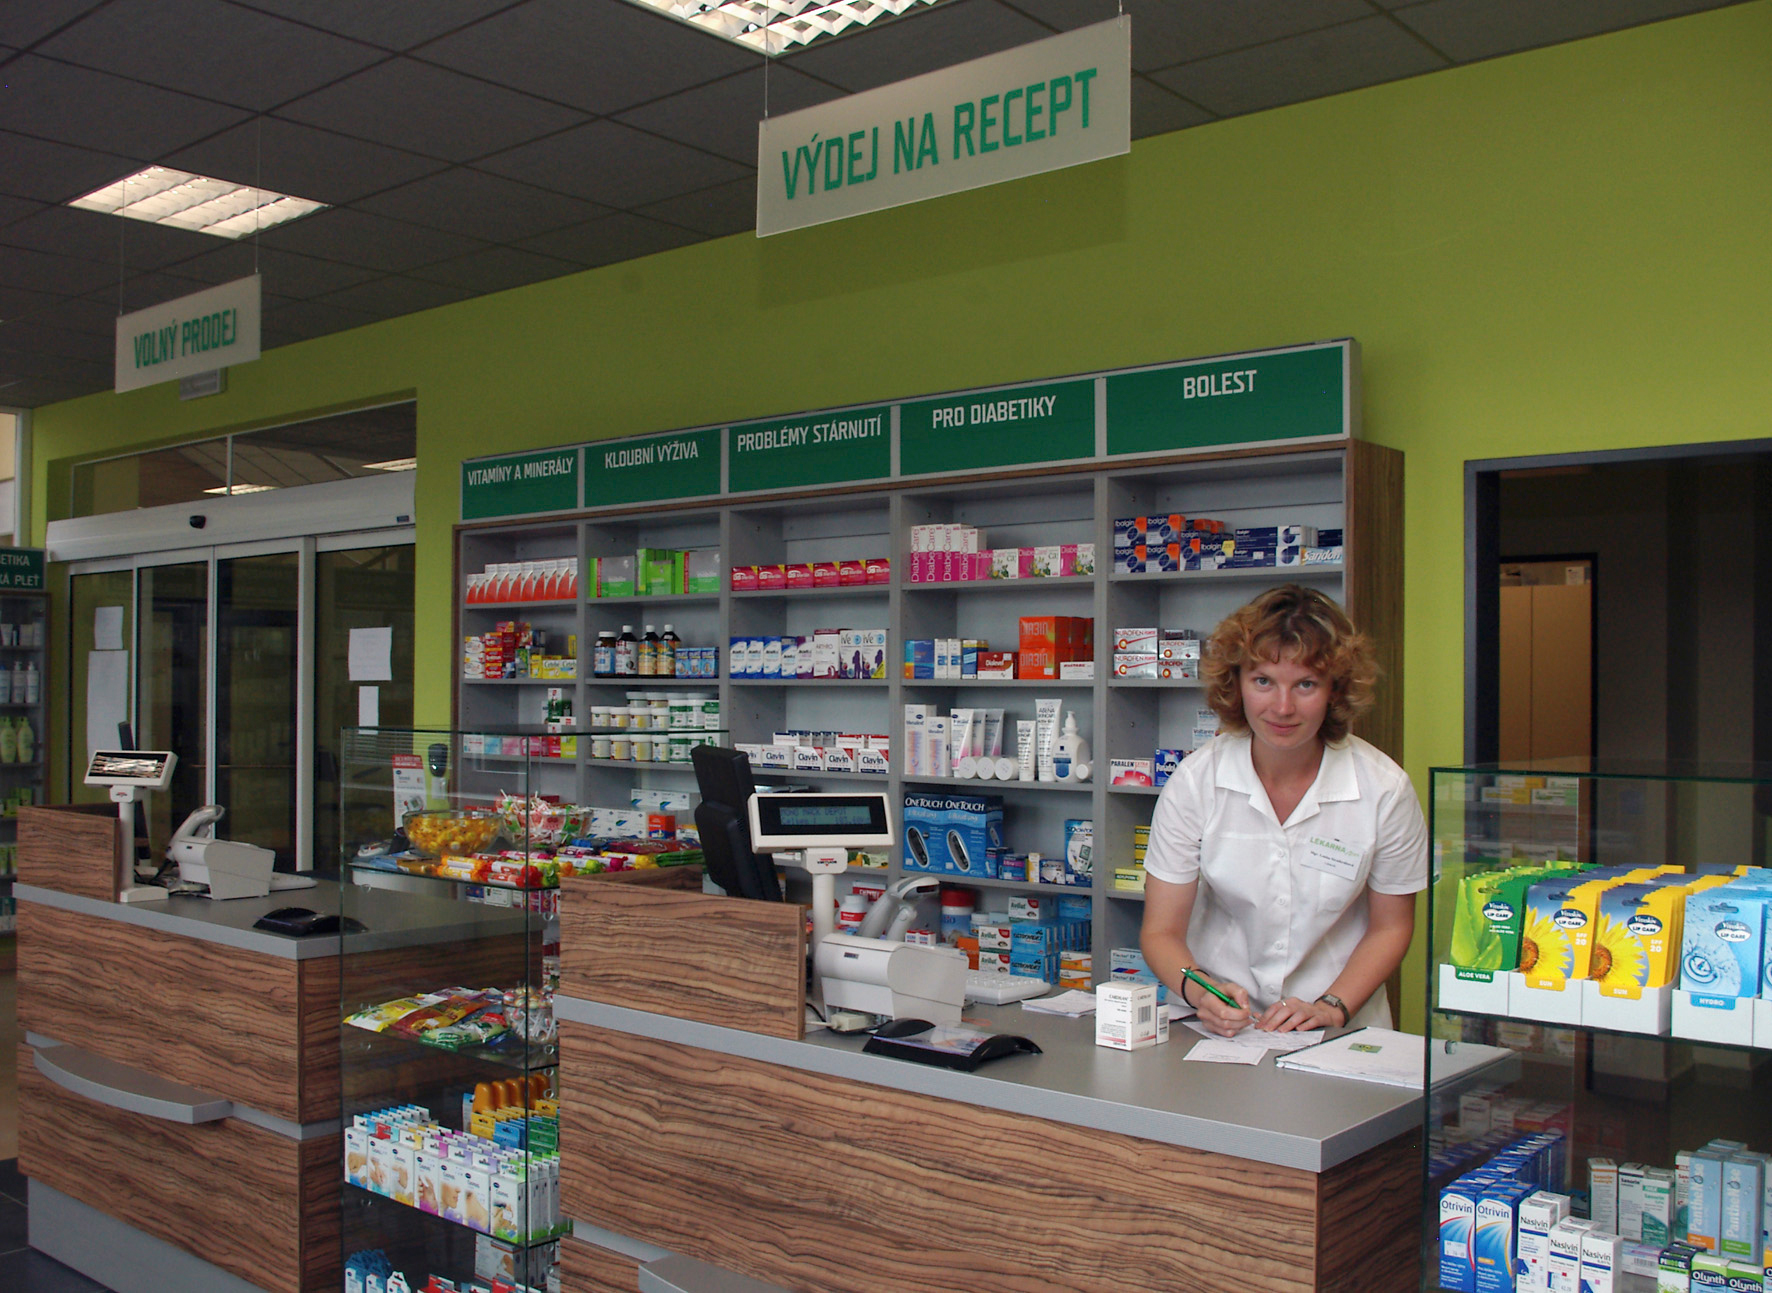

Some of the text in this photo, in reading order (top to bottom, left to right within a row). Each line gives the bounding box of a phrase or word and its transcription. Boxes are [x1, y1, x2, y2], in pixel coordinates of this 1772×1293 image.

[782, 67, 1097, 200] VÝDEJ NA RECEPT
[134, 308, 237, 369] VOLNÝ PRODEJ
[1183, 370, 1257, 399] BOLEST
[932, 396, 1056, 429] PRO DIABETIKY
[737, 415, 882, 452] PROBLÉMY STÁRNUTÍ
[604, 440, 698, 469] KLOUBNÍ VÝŽIVA
[468, 457, 574, 486] VITAMÍNY A MINERÁLY
[766, 752, 784, 760] Clavin
[798, 752, 818, 761] Clavin
[829, 754, 848, 763] Clavin
[862, 755, 883, 765] Clavin
[1458, 971, 1474, 979] ALOE
[1699, 998, 1725, 1006] HYDRO
[1441, 1200, 1472, 1214] Otrivin
[1477, 1205, 1510, 1219] Otrivin
[1520, 1216, 1548, 1228] Nasivin
[1550, 1239, 1578, 1252] Nasivin
[1582, 1249, 1611, 1261] Nasivin
[1692, 1271, 1725, 1285] Olynth
[1729, 1278, 1762, 1293] Olynth
